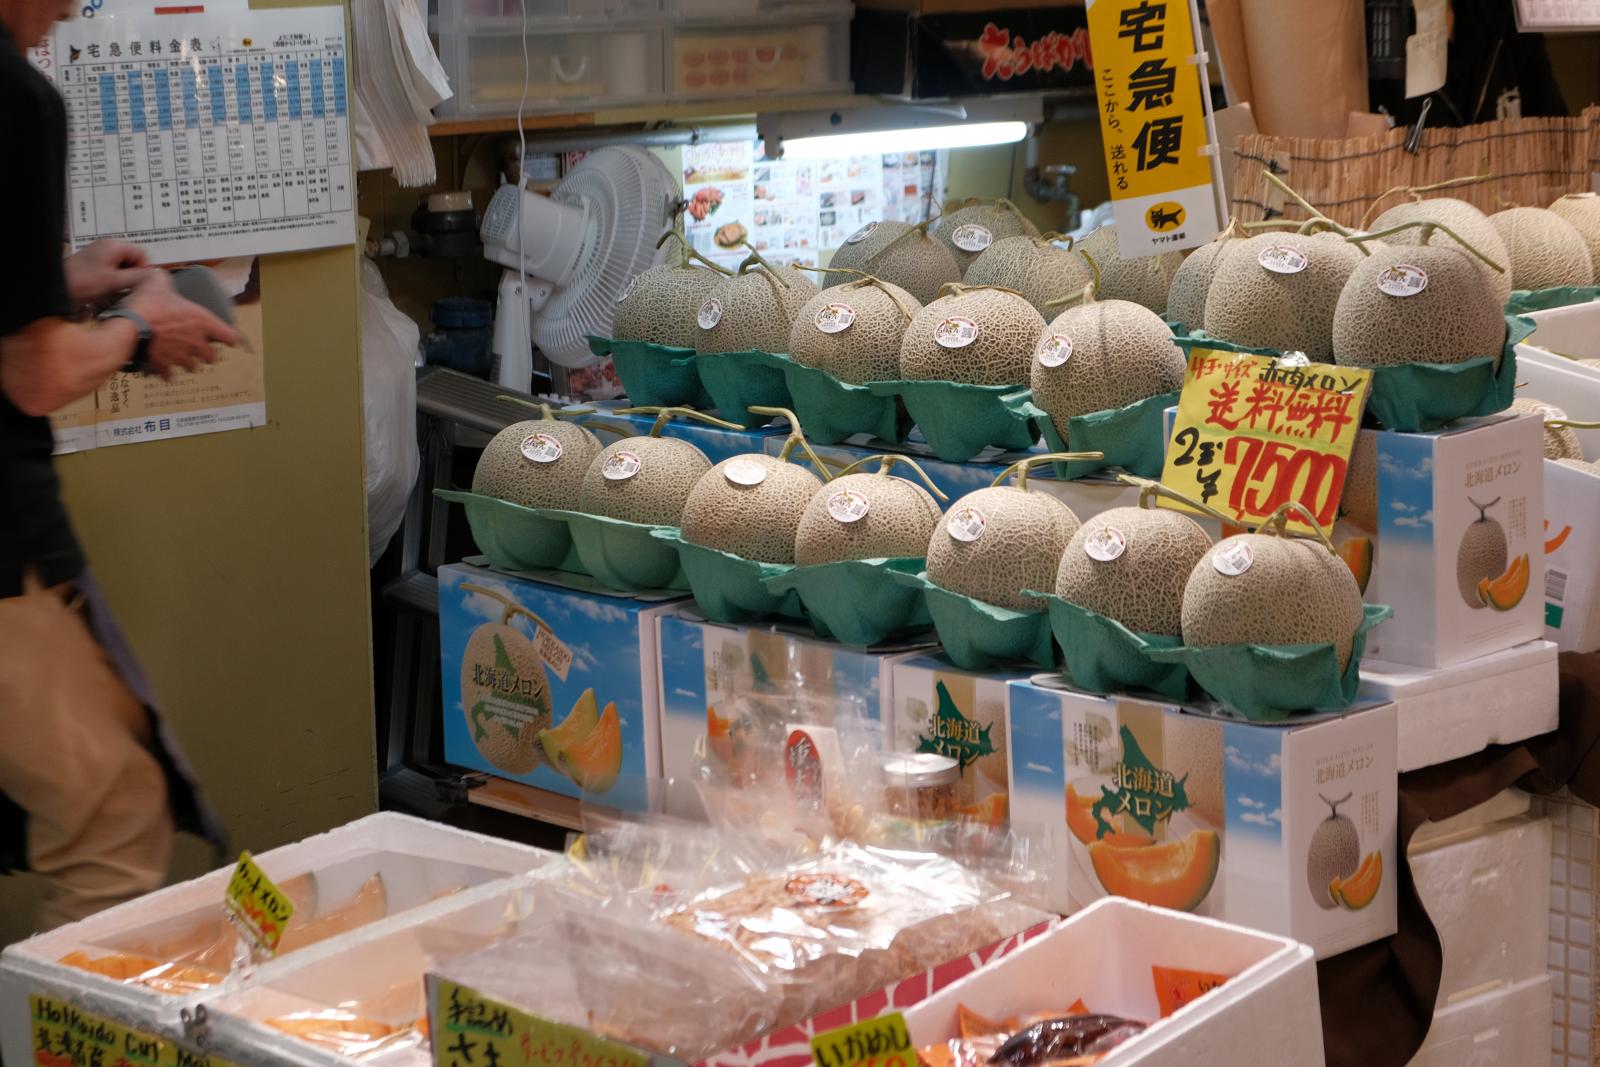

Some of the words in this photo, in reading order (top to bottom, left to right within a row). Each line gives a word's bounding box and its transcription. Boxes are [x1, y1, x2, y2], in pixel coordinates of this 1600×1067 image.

[86, 37, 203, 59] 宅急便料金表
[1117, 0, 1184, 172] 宅急便
[143, 418, 171, 432] 布目
[1204, 380, 1355, 445] 送料無料
[1464, 462, 1522, 489] 北海道メロン
[472, 662, 545, 699] 北海道メロン
[929, 714, 981, 745] 北海道
[1112, 761, 1174, 798] 北海道
[1315, 755, 1375, 785] 北海道メロン
[1116, 794, 1175, 823] メロン
